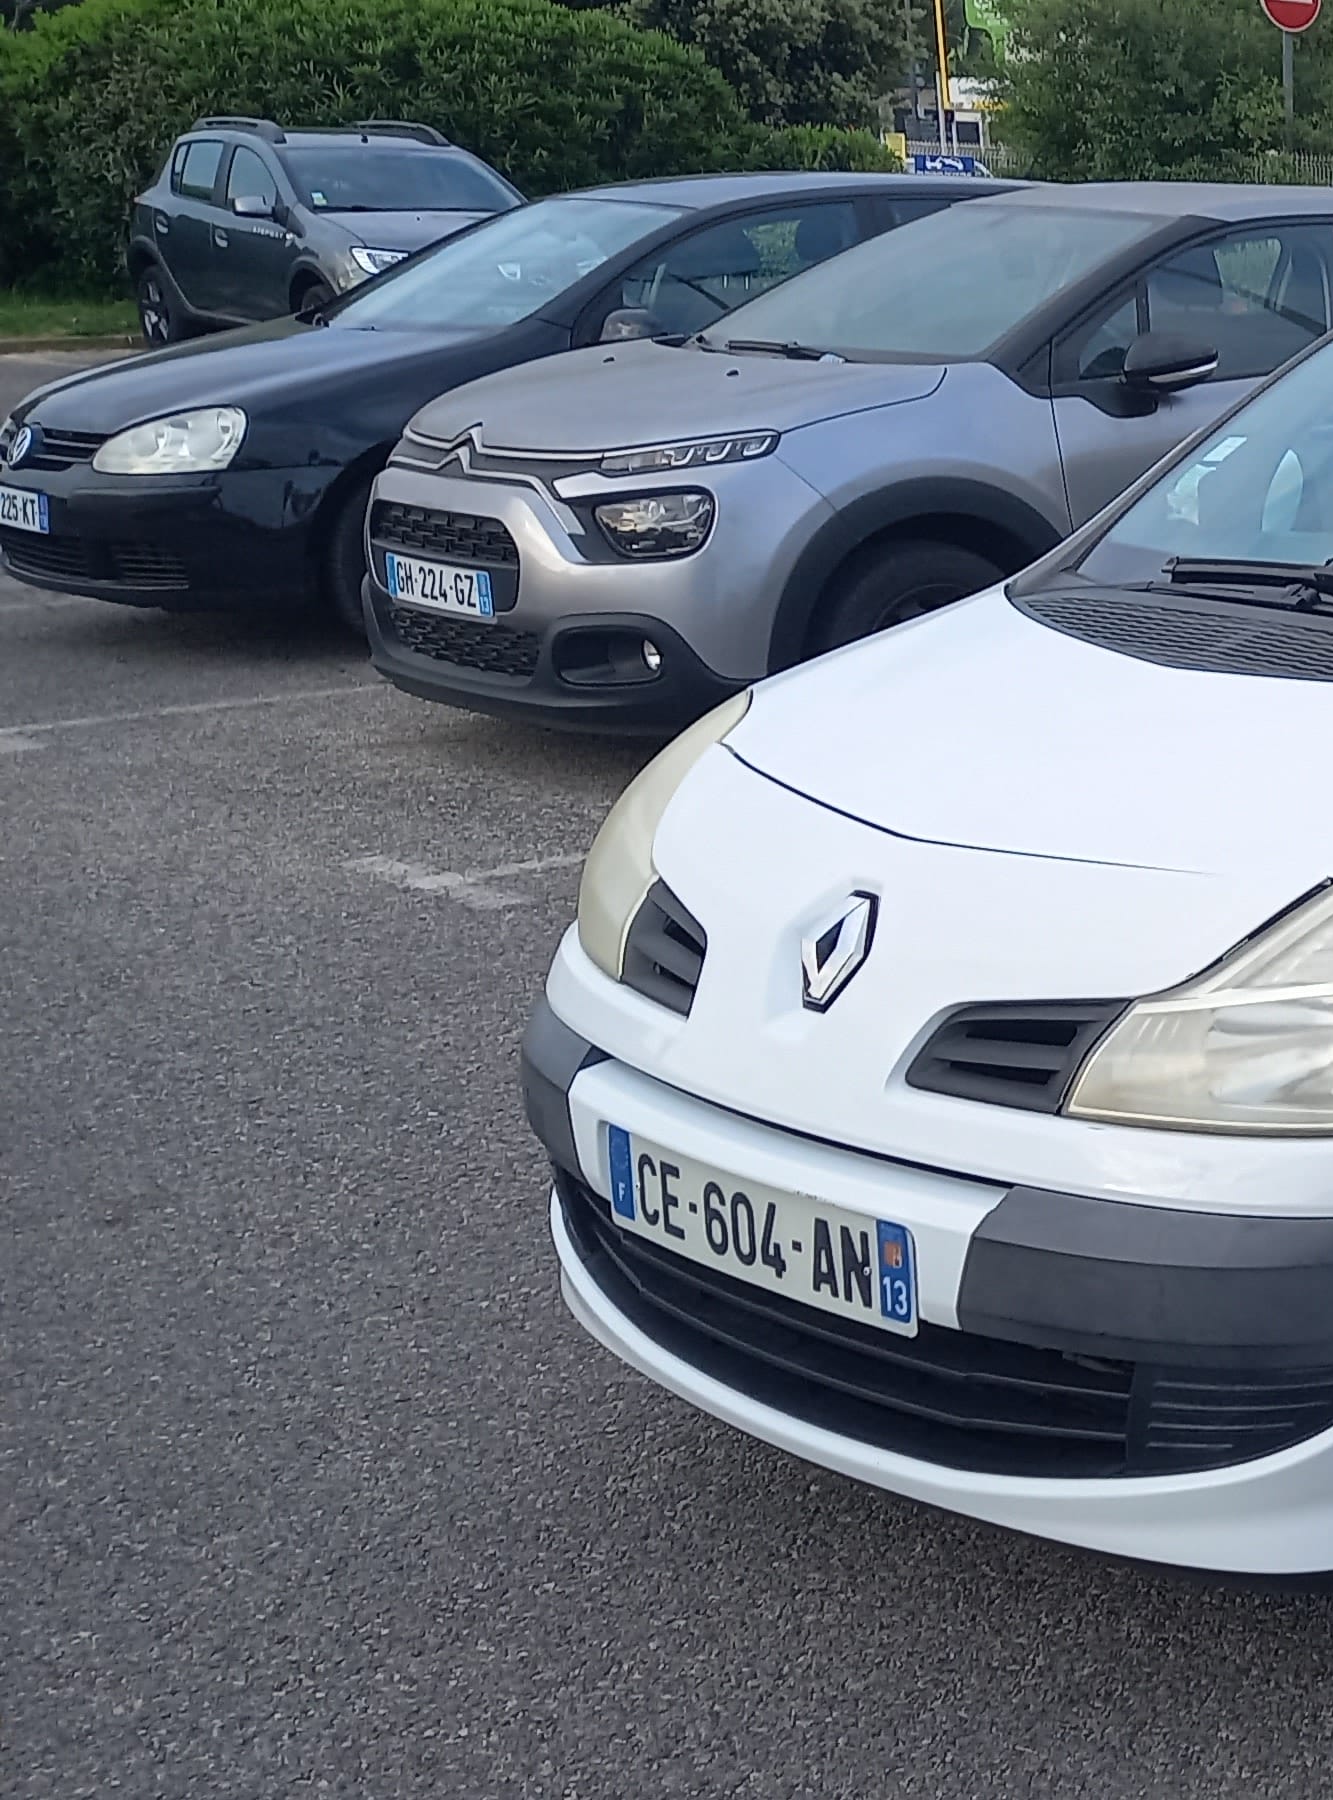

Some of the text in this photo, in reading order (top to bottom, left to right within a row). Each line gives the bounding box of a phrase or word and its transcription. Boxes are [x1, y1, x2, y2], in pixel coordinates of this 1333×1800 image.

[396, 561, 477, 609] GH-224-GZ
[618, 1153, 908, 1316] F CE-604-AN 13
